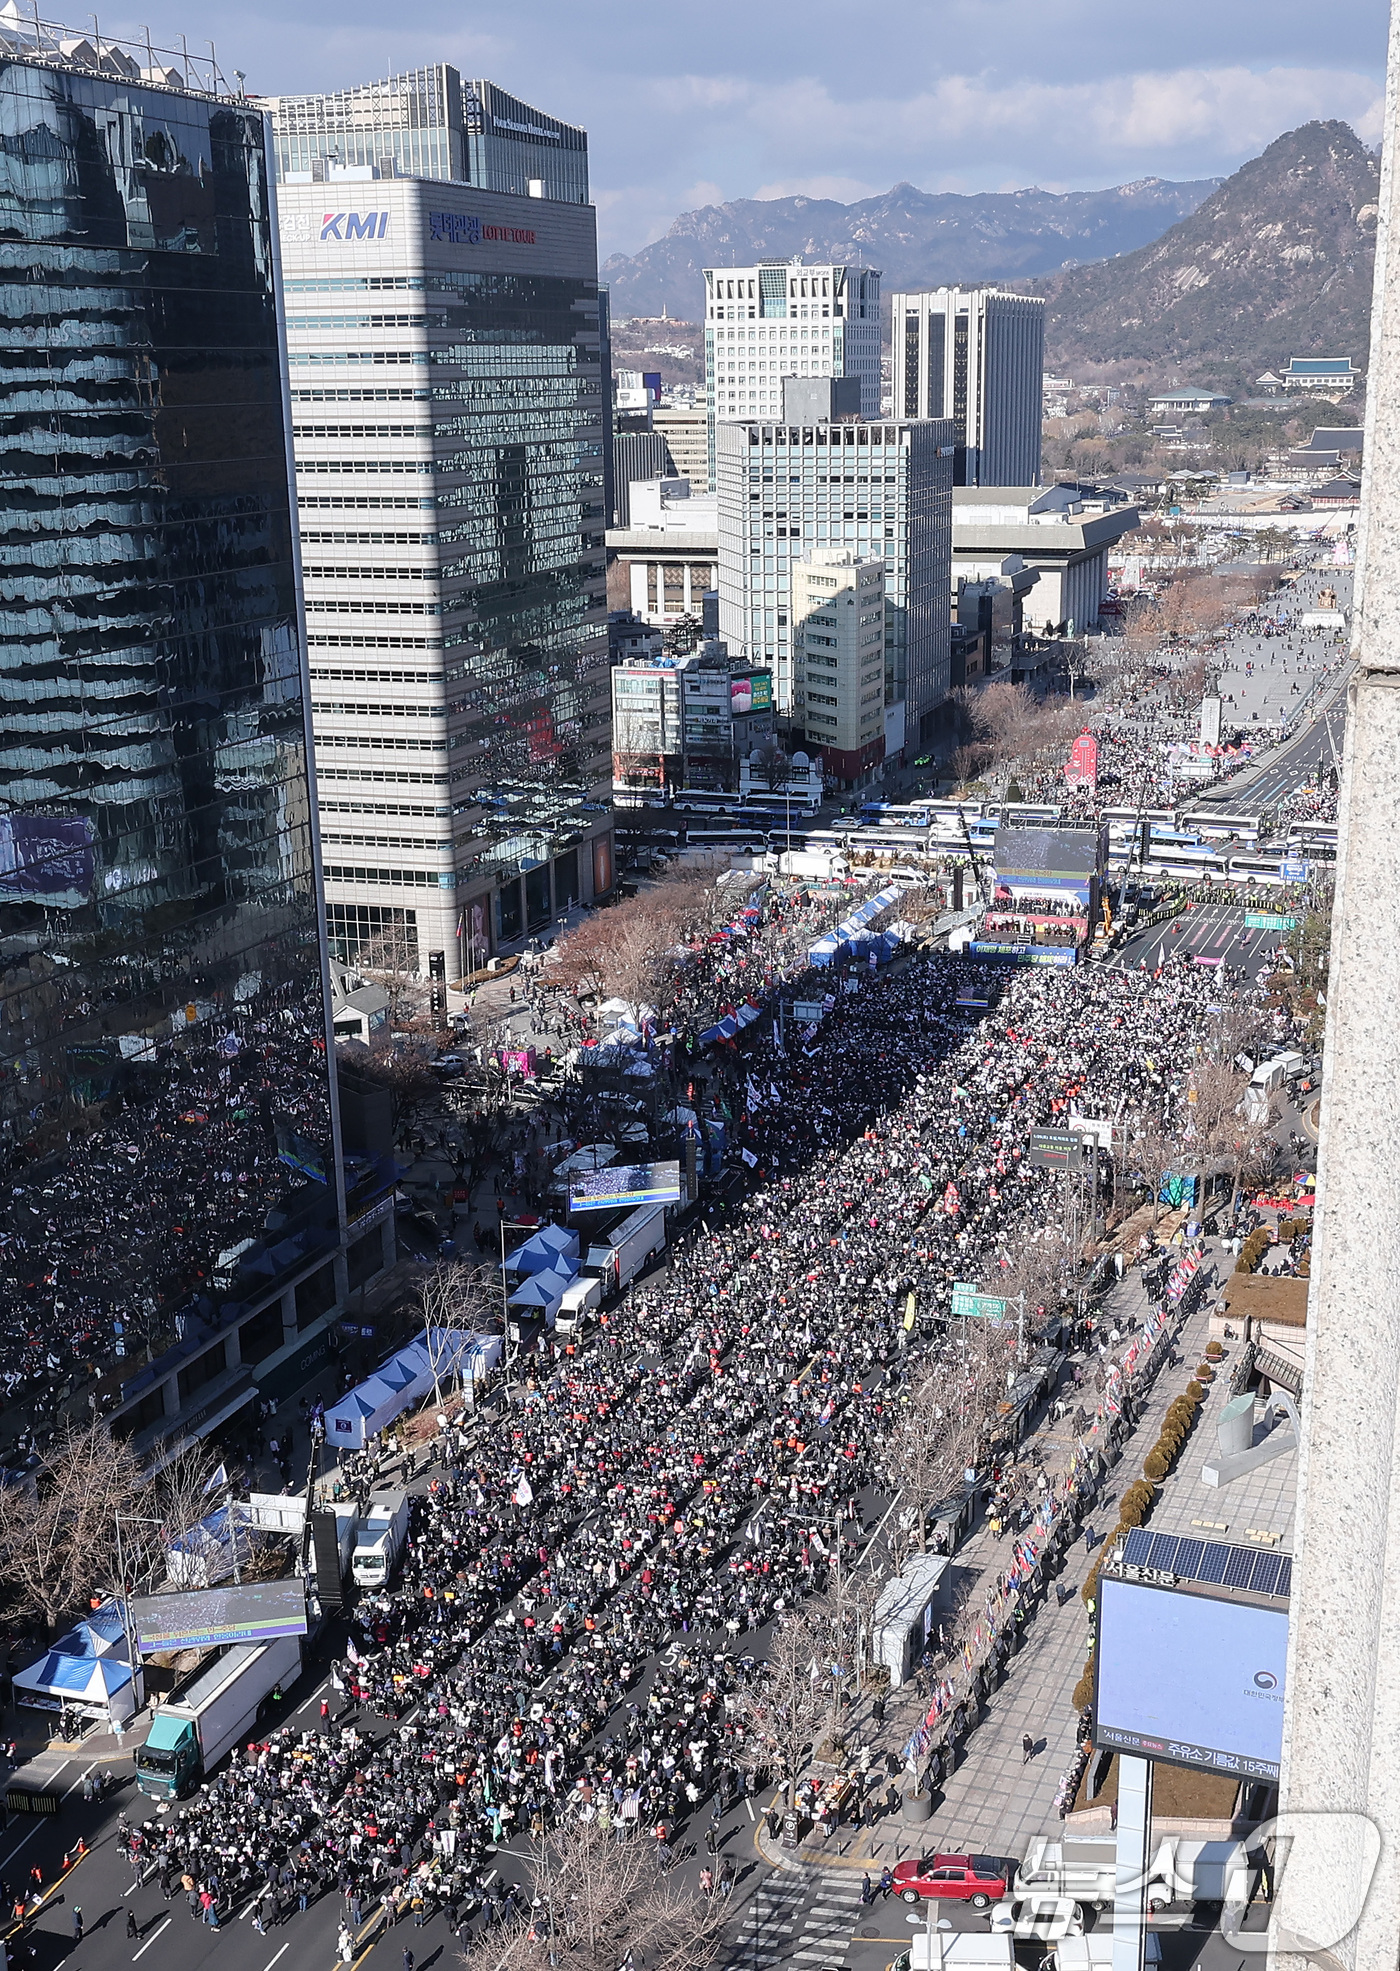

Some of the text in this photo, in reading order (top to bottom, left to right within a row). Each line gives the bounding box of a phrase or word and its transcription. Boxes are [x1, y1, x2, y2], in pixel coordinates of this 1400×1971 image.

[320, 211, 389, 241] KMI
[429, 211, 536, 245] 롯데관광 LOTTE TOUR
[796, 268, 815, 276] 외교부
[1107, 1561, 1175, 1587] 서울신문
[1168, 1742, 1203, 1761] 주유소
[1204, 1750, 1241, 1769] 기름값
